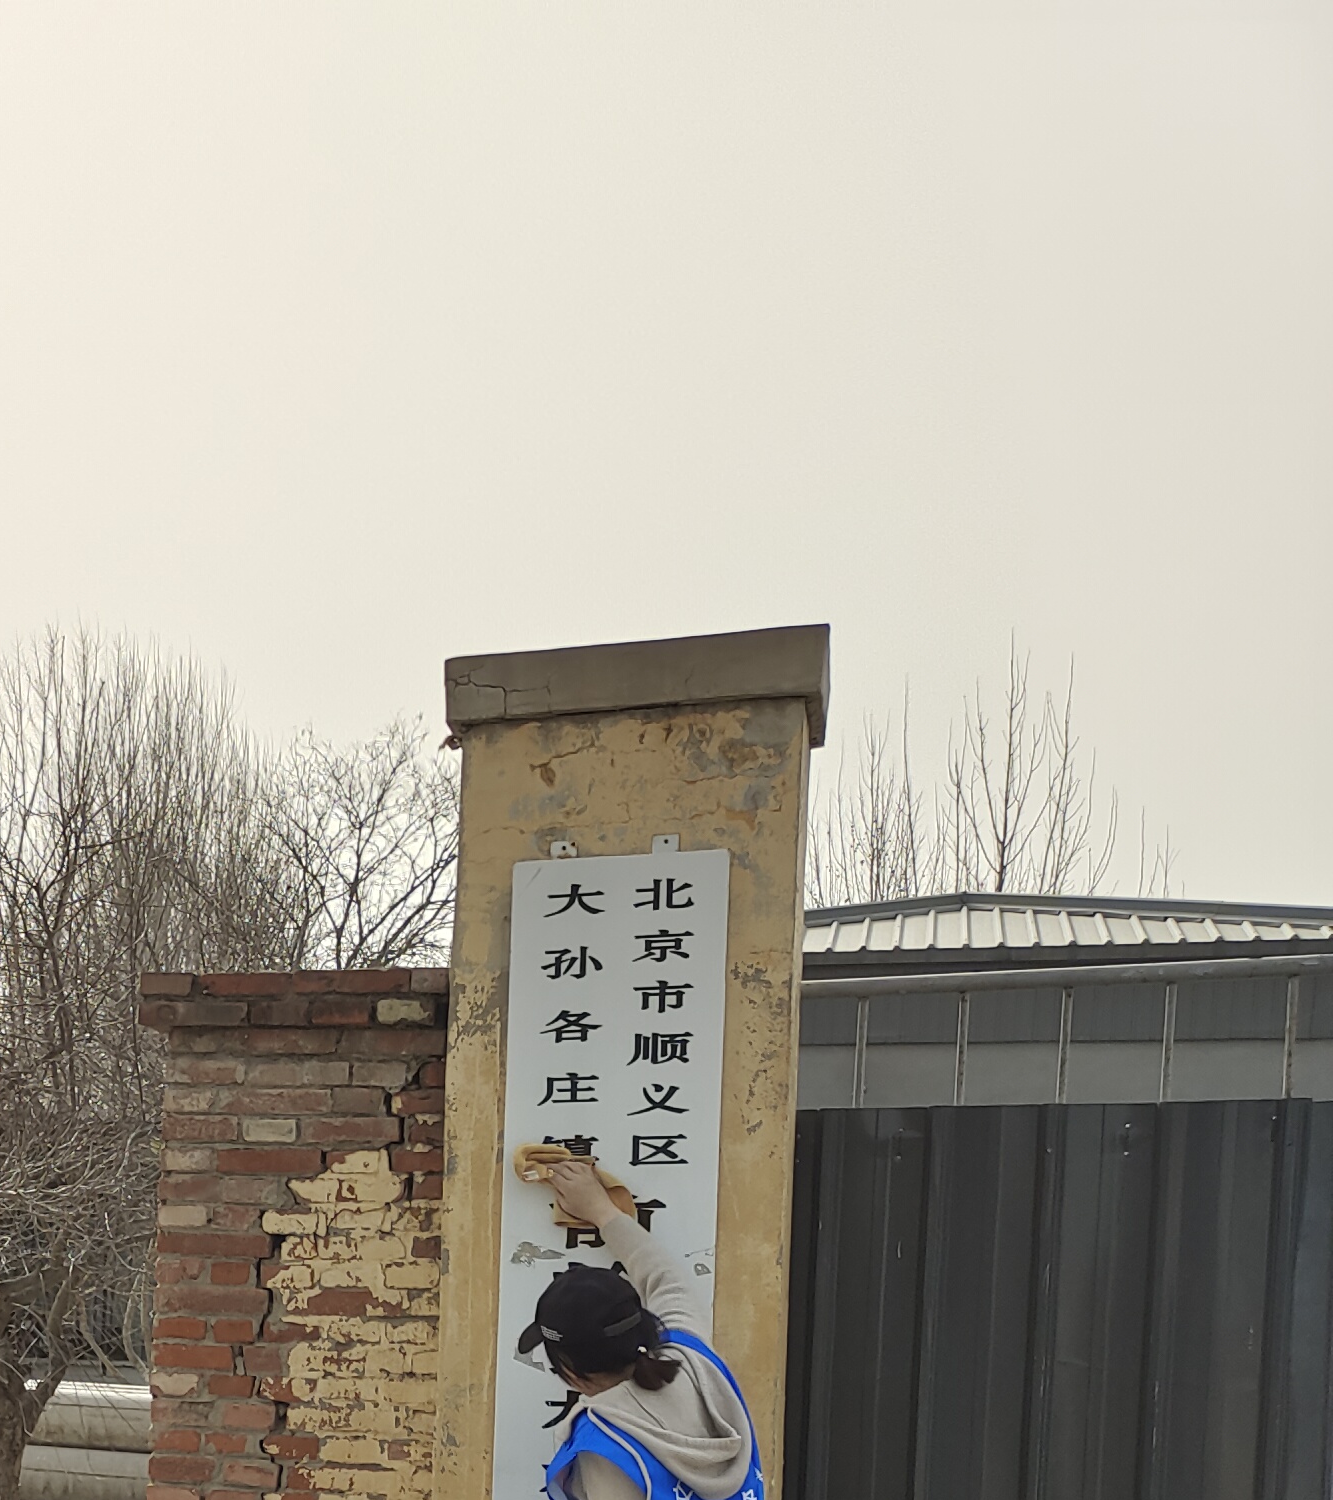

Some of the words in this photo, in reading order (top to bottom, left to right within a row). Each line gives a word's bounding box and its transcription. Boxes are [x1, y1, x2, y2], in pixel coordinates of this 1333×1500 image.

[626, 877, 695, 1167] 北京市顺义区
